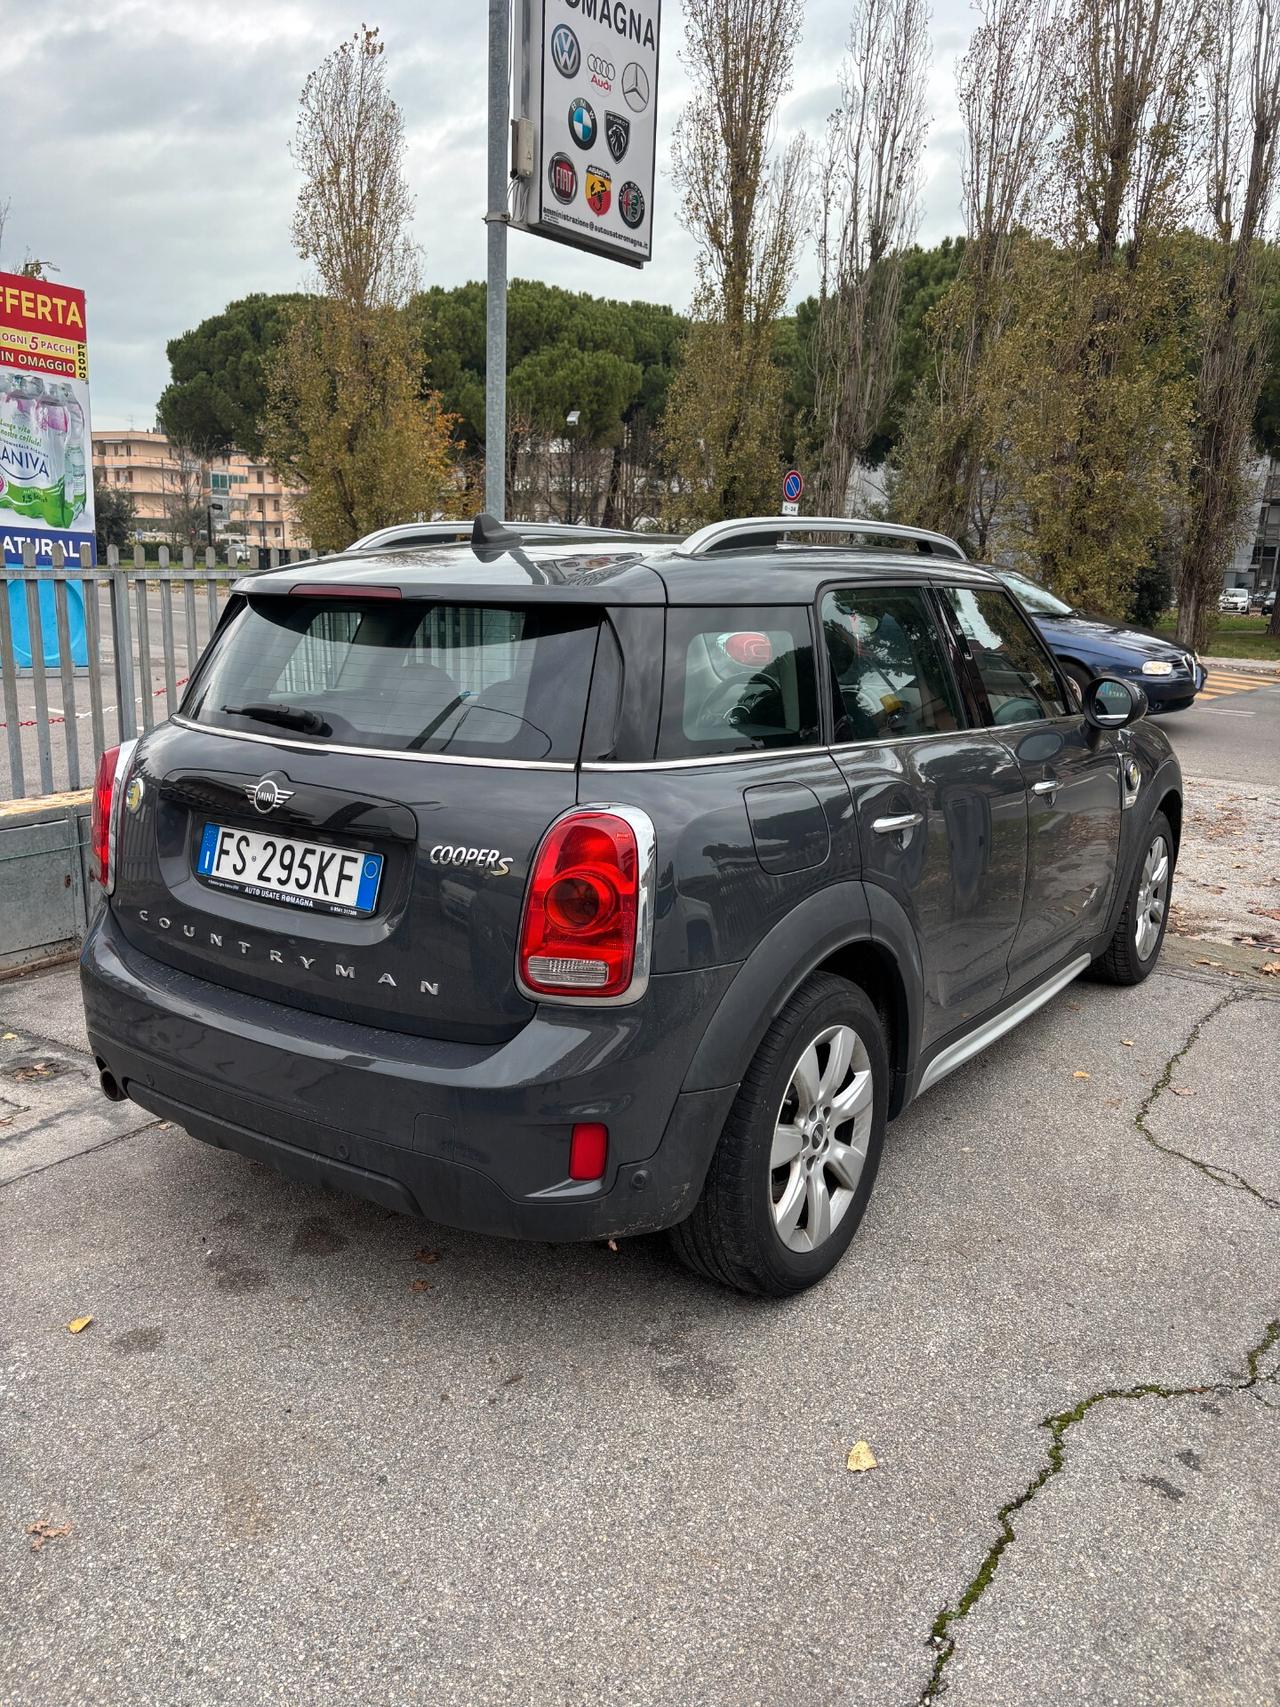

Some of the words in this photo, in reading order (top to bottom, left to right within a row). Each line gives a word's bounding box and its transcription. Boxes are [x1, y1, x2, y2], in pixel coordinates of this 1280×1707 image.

[591, 74, 611, 91] Audi
[571, 99, 595, 120] BMW
[557, 166, 572, 192] FIAT
[2, 333, 27, 345] OGNI
[29, 336, 39, 351] 5
[41, 340, 75, 354] PACCHI
[1, 350, 14, 363] IN
[18, 354, 75, 373] OMAGGIO
[78, 343, 87, 379] PROMO
[0, 445, 49, 478] ANIVA
[256, 791, 275, 802] MINI
[215, 831, 250, 876] FS
[257, 840, 358, 898] 295KF
[430, 845, 500, 869] COOPER
[244, 886, 260, 896] AUTO
[261, 891, 280, 901] USATE
[281, 894, 314, 908] ROMAGNA
[139, 909, 440, 996] COUNTRYMAN
